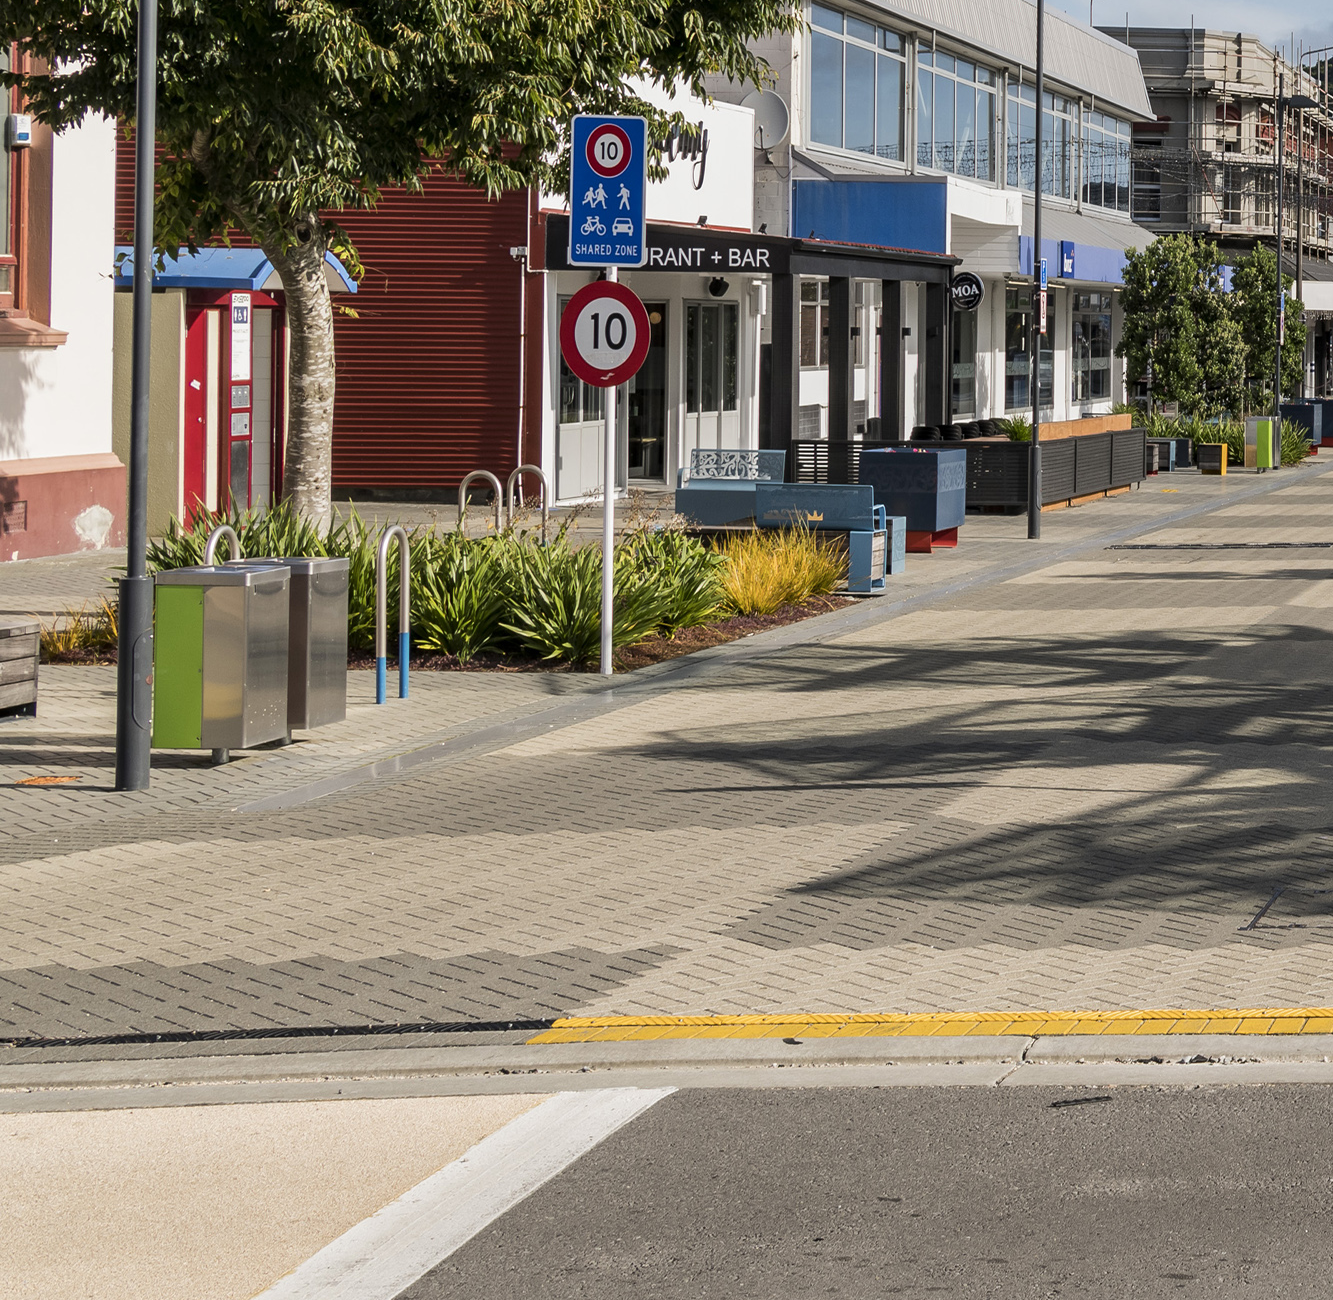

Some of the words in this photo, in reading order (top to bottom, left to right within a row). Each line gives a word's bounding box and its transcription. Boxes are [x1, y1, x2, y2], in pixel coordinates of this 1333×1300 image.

[600, 141, 618, 161] 10
[575, 243, 612, 256] SHARED
[614, 244, 638, 257] ZONE
[728, 248, 770, 267] BAR
[951, 283, 979, 298] MOA
[591, 312, 627, 351] 10
